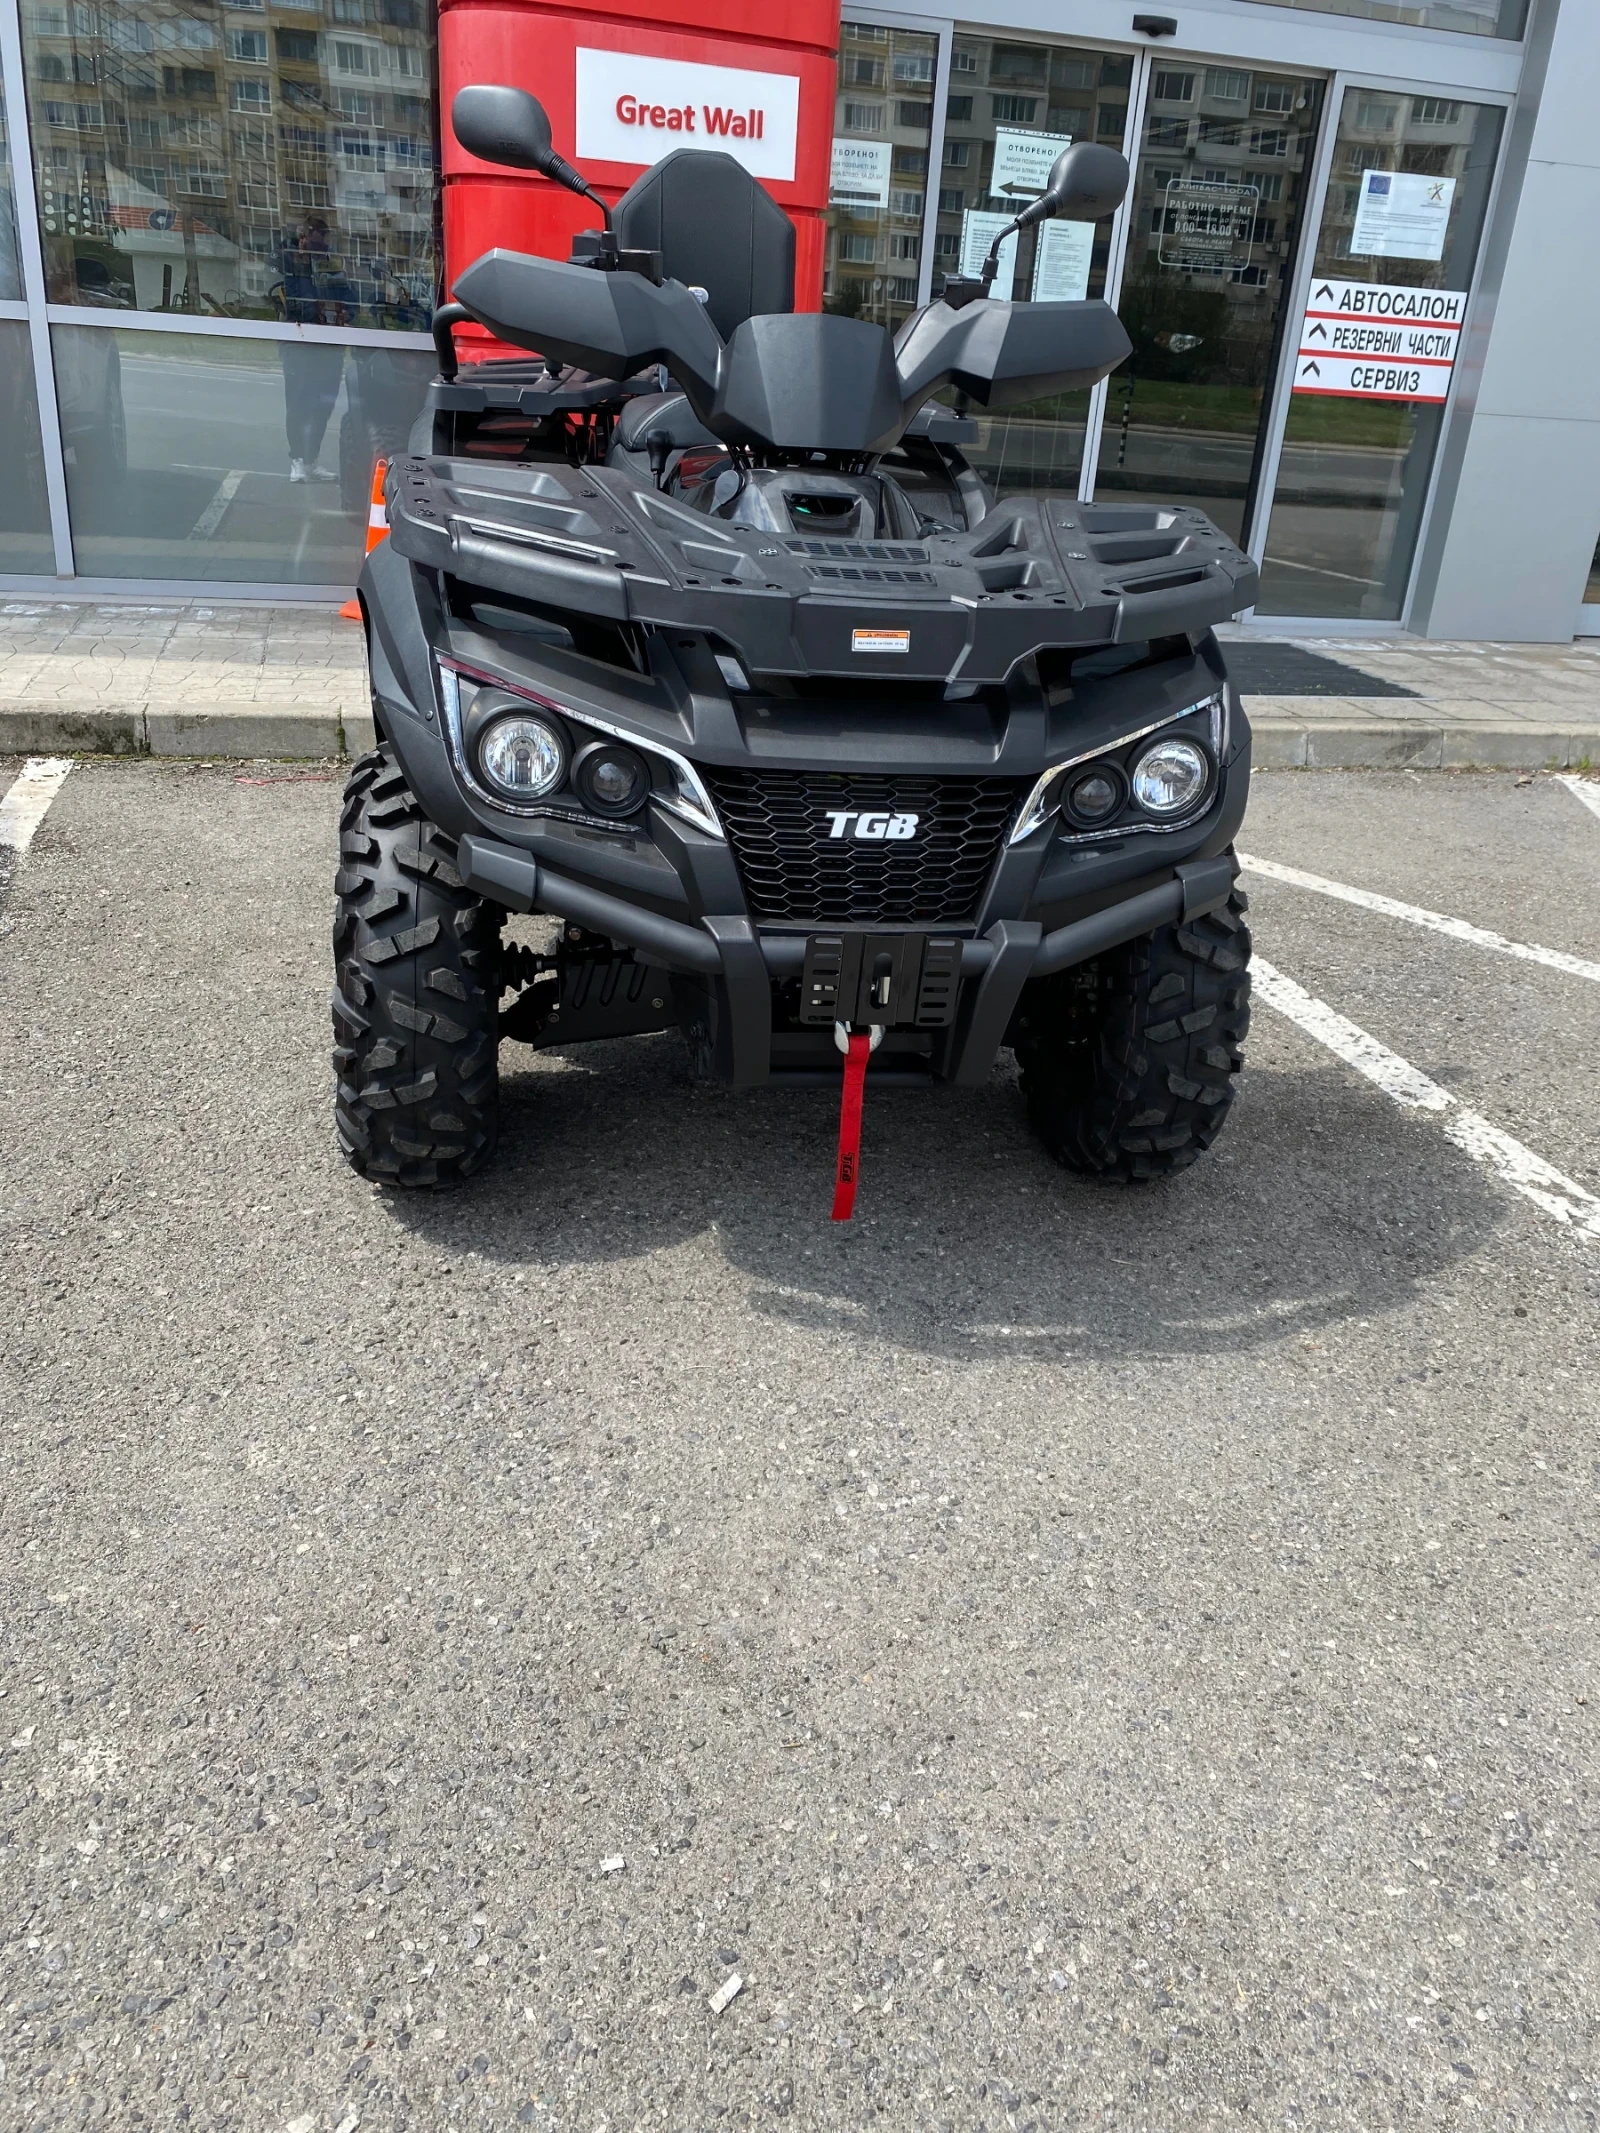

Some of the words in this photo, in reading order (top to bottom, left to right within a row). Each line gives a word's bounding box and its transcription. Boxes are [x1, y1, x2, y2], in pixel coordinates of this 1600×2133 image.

[616, 94, 696, 132] Great
[703, 105, 764, 139] Wall
[833, 148, 878, 159] ТВОРЕНО!
[1008, 144, 1057, 156] ОТВОРЕНО!
[1169, 200, 1215, 212] РАБОТНО
[1220, 204, 1253, 215] ВРЕМЕ
[1338, 288, 1460, 320] АВТОСАЛОН
[1332, 327, 1403, 354] РЕЗЕРВНИ
[1408, 333, 1452, 357] ЧАСТИ
[1350, 366, 1421, 392] СЕРВИЗ
[825, 811, 920, 839] TGB
[841, 1152, 855, 1184] TGB
